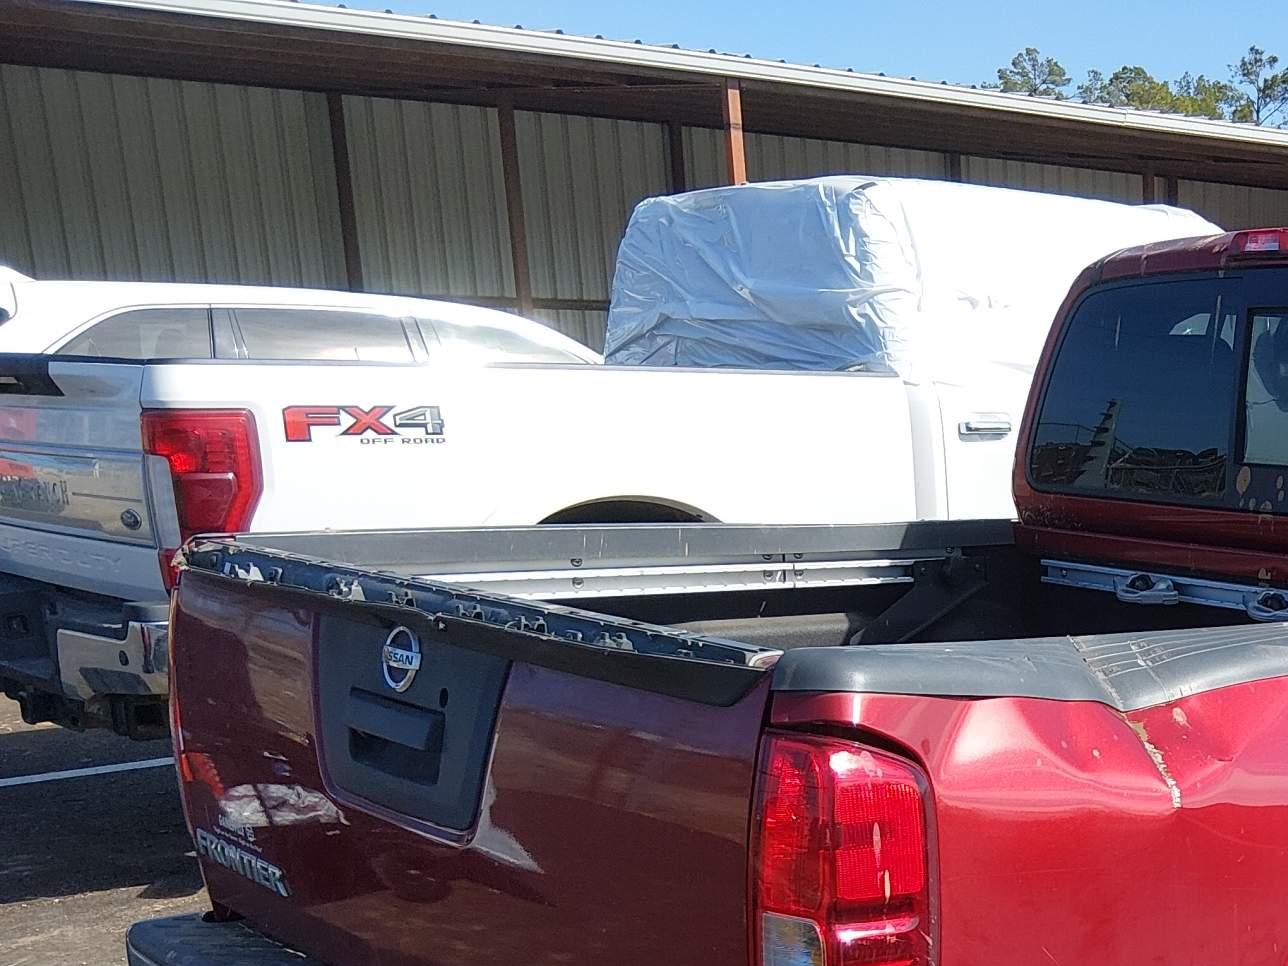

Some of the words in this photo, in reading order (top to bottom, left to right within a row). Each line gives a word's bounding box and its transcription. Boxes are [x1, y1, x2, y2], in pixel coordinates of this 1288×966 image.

[282, 405, 444, 442] FX4
[360, 437, 395, 445] OFF
[402, 437, 446, 445] ROAD
[196, 828, 290, 897] FRONTIER
